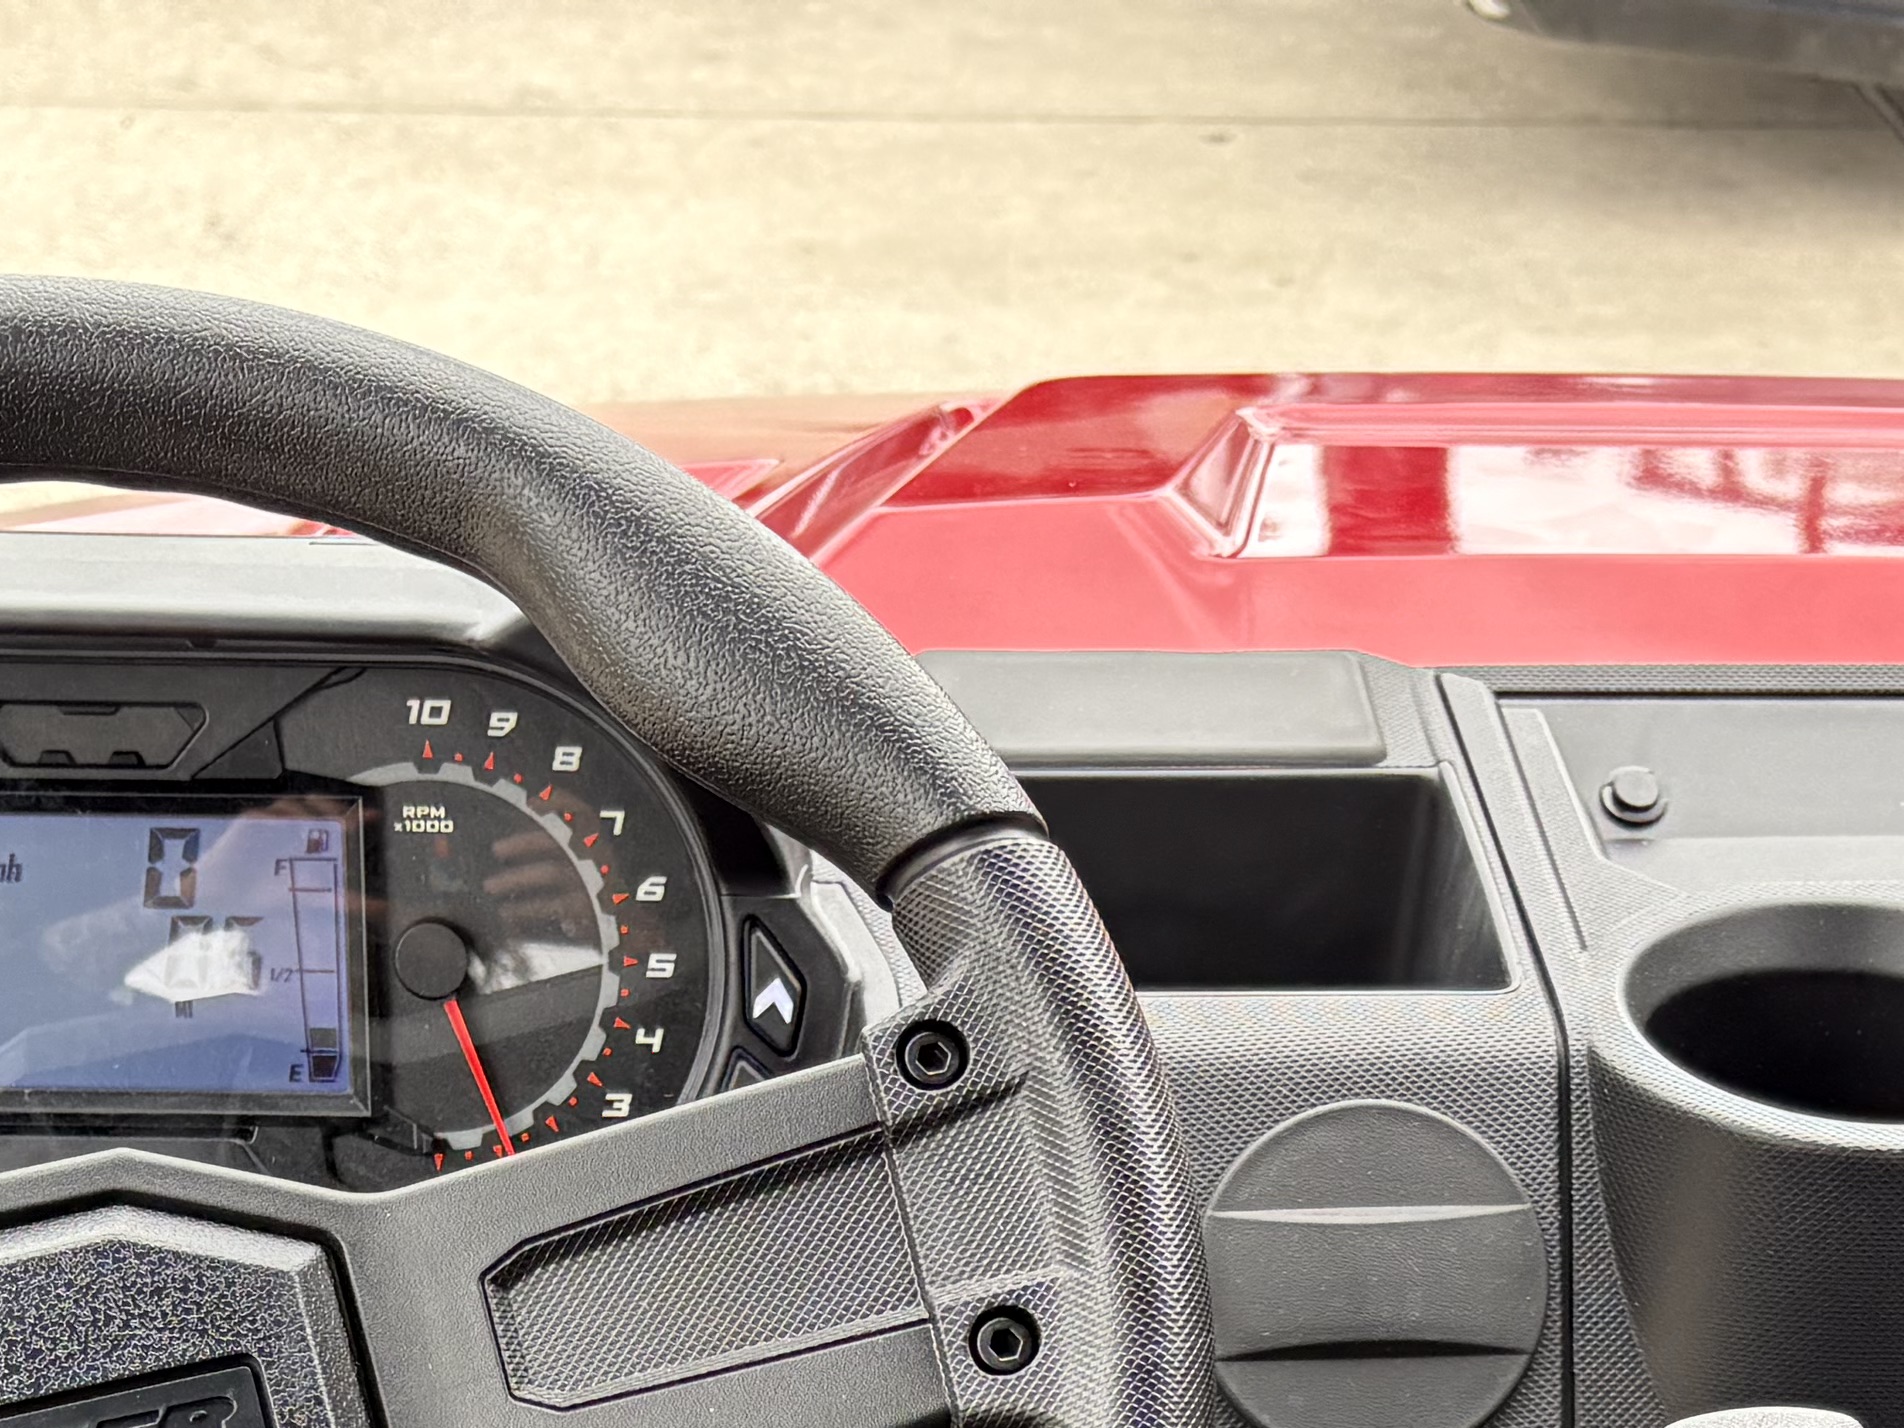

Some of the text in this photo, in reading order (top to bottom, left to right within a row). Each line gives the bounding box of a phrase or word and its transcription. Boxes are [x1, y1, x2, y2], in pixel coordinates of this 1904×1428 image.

[406, 699, 451, 725] 10
[487, 711, 518, 737] 9
[552, 746, 583, 772] 8
[402, 805, 445, 819] RPM
[599, 810, 625, 836] 7
[394, 819, 454, 833] x1000
[144, 827, 200, 909] 0
[274, 858, 288, 876] F
[635, 876, 667, 901] 6
[270, 967, 293, 983] 1/2
[646, 953, 677, 978] 5
[635, 1027, 664, 1053] 4
[289, 1063, 304, 1082] E
[602, 1093, 633, 1118] 3
